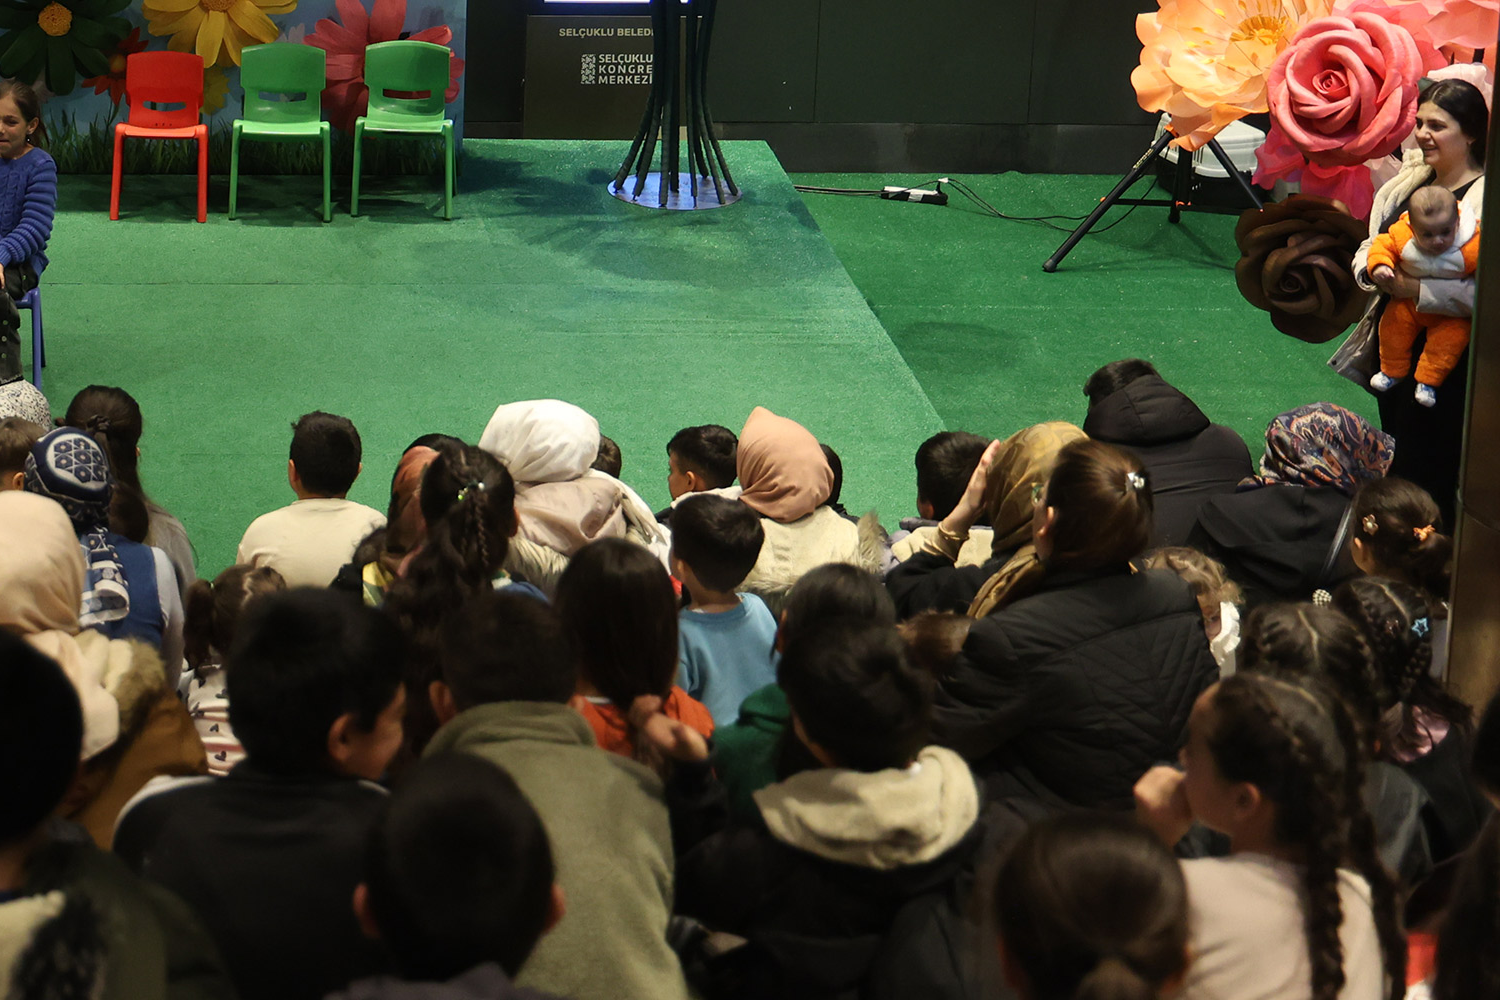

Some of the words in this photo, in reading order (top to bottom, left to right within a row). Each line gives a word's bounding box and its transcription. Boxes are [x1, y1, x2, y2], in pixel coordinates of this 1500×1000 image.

[559, 28, 614, 39] SELÇUKLU
[598, 54, 654, 65] SELÇUKLU
[598, 65, 653, 74] KONGRE
[598, 74, 653, 85] MERKEZİ
